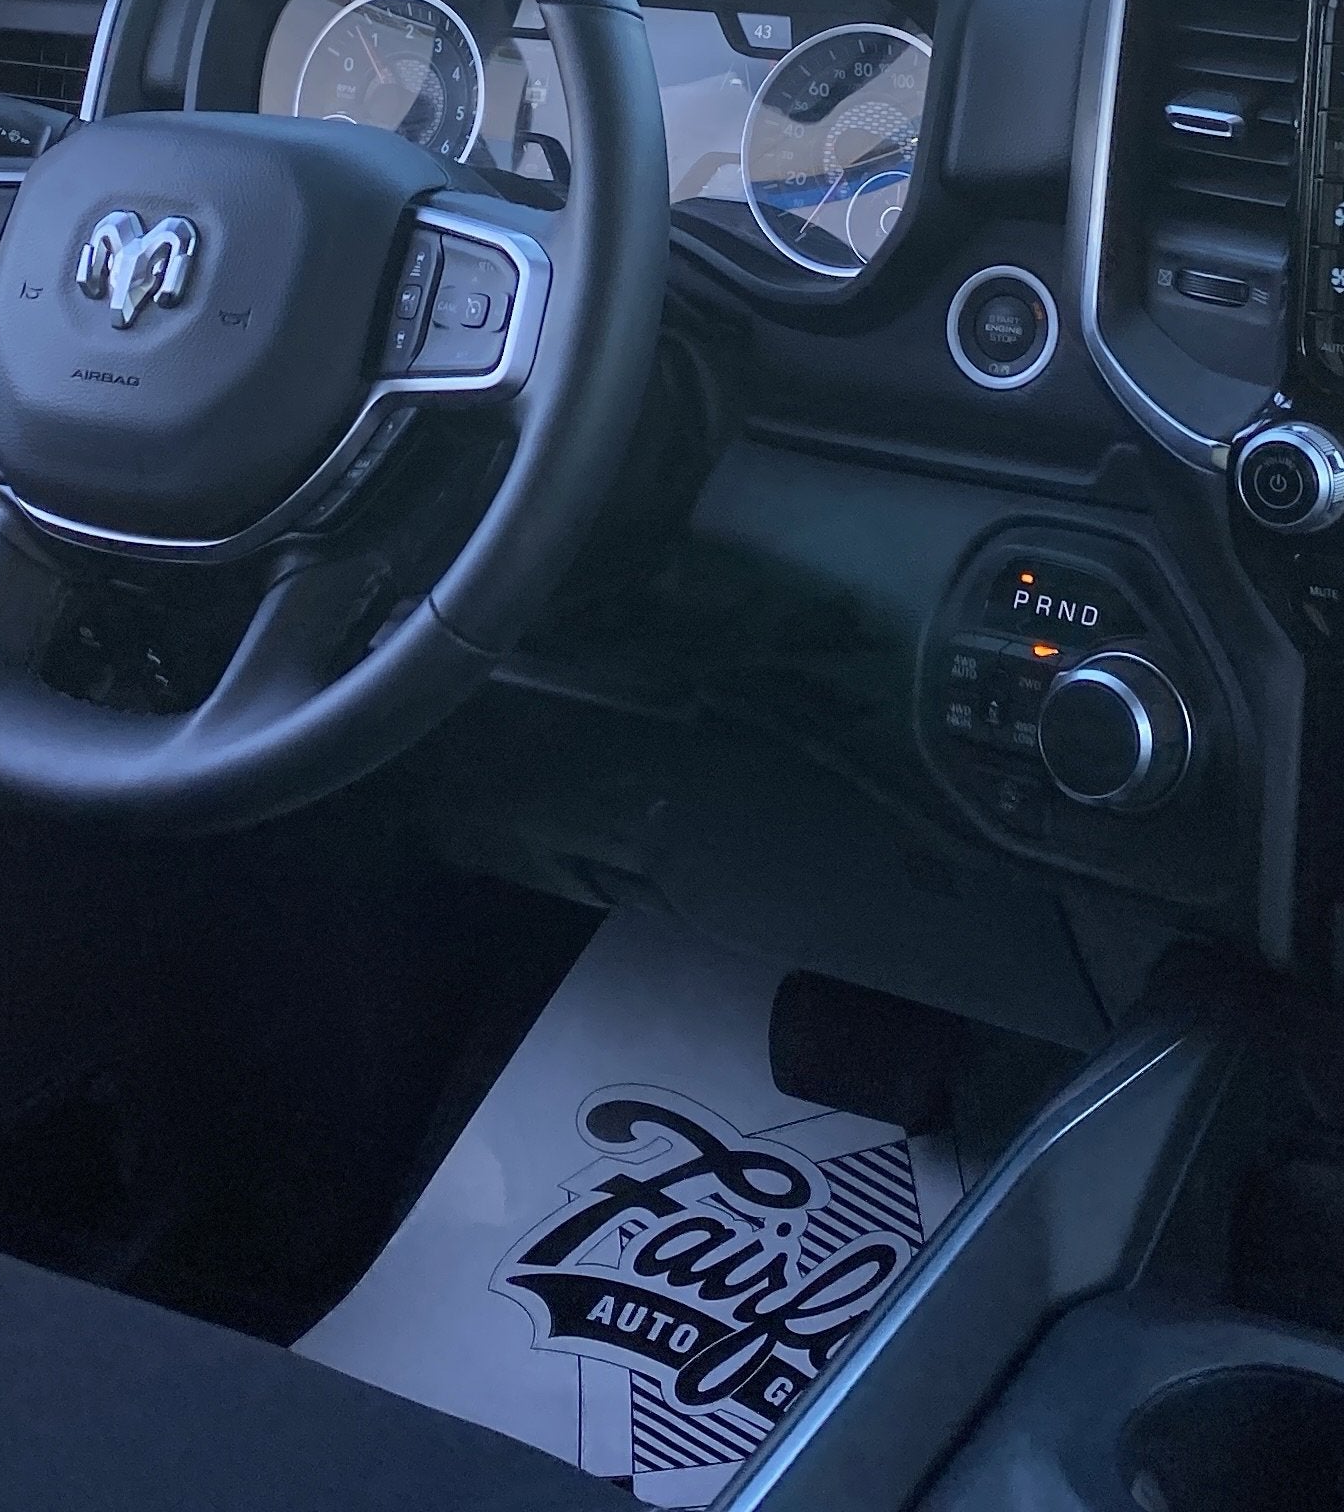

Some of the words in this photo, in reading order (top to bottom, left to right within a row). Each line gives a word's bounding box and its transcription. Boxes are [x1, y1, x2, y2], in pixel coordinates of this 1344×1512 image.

[406, 24, 414, 38] 2
[754, 24, 772, 39] 43
[372, 33, 379, 47] 1
[435, 38, 444, 54] 3
[343, 57, 354, 72] 0
[854, 62, 873, 77] 80
[452, 67, 461, 82] 4
[834, 69, 846, 80] 70
[891, 74, 915, 89] 100
[808, 82, 830, 98] 60
[455, 105, 465, 120] 5
[784, 123, 805, 139] 40
[440, 140, 450, 155] 6
[785, 171, 807, 186] 20
[984, 323, 1024, 337] ENGINE
[989, 333, 1017, 345] STOP
[70, 367, 141, 388] AIRBAG
[586, 1294, 700, 1354] AUTO
